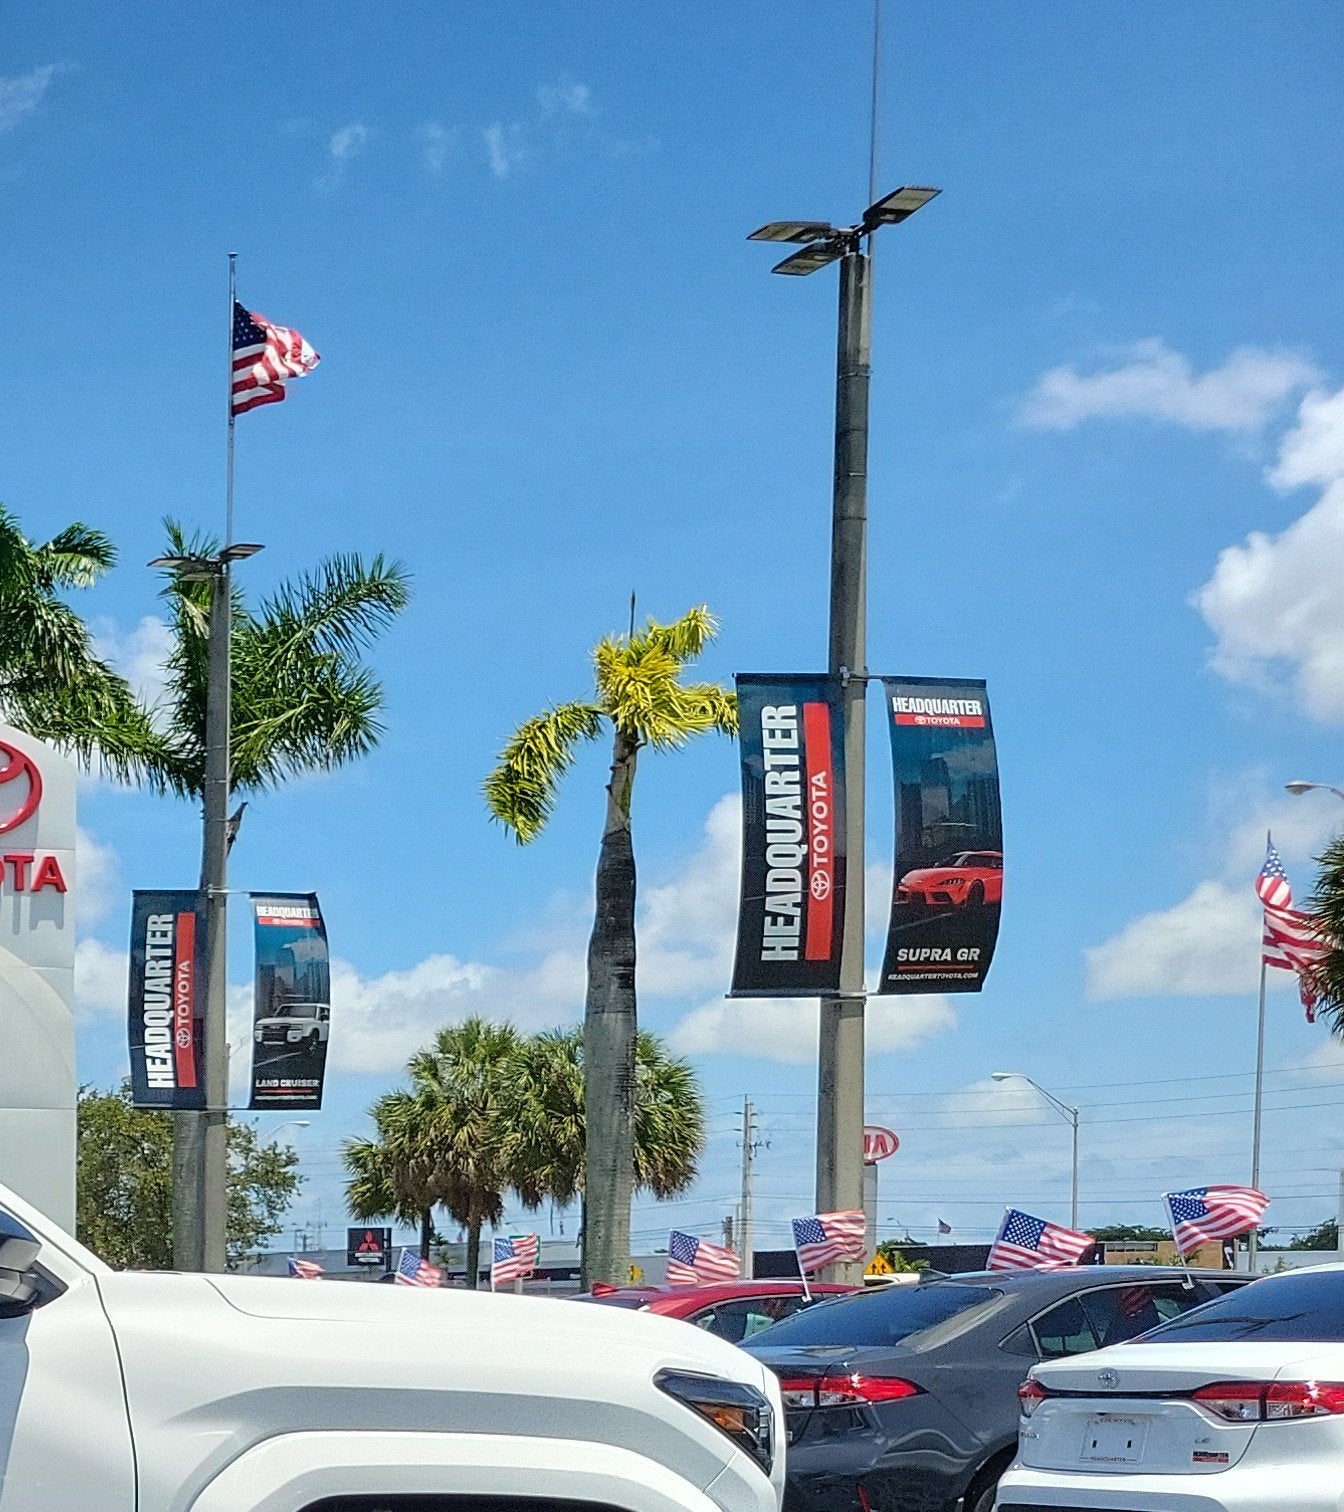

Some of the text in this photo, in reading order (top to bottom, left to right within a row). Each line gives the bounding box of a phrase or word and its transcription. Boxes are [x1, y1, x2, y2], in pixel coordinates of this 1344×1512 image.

[892, 697, 982, 715] HEADQUARTER
[927, 716, 961, 725] TOYOTA
[761, 705, 807, 961] HEADQUARTER
[811, 770, 830, 867] TOYOTA
[897, 947, 981, 961] SUPRA GR
[143, 913, 176, 1088] HEADQUARTER
[177, 960, 190, 1026] TOYOTA
[255, 1079, 320, 1088] LAND CRUISER
